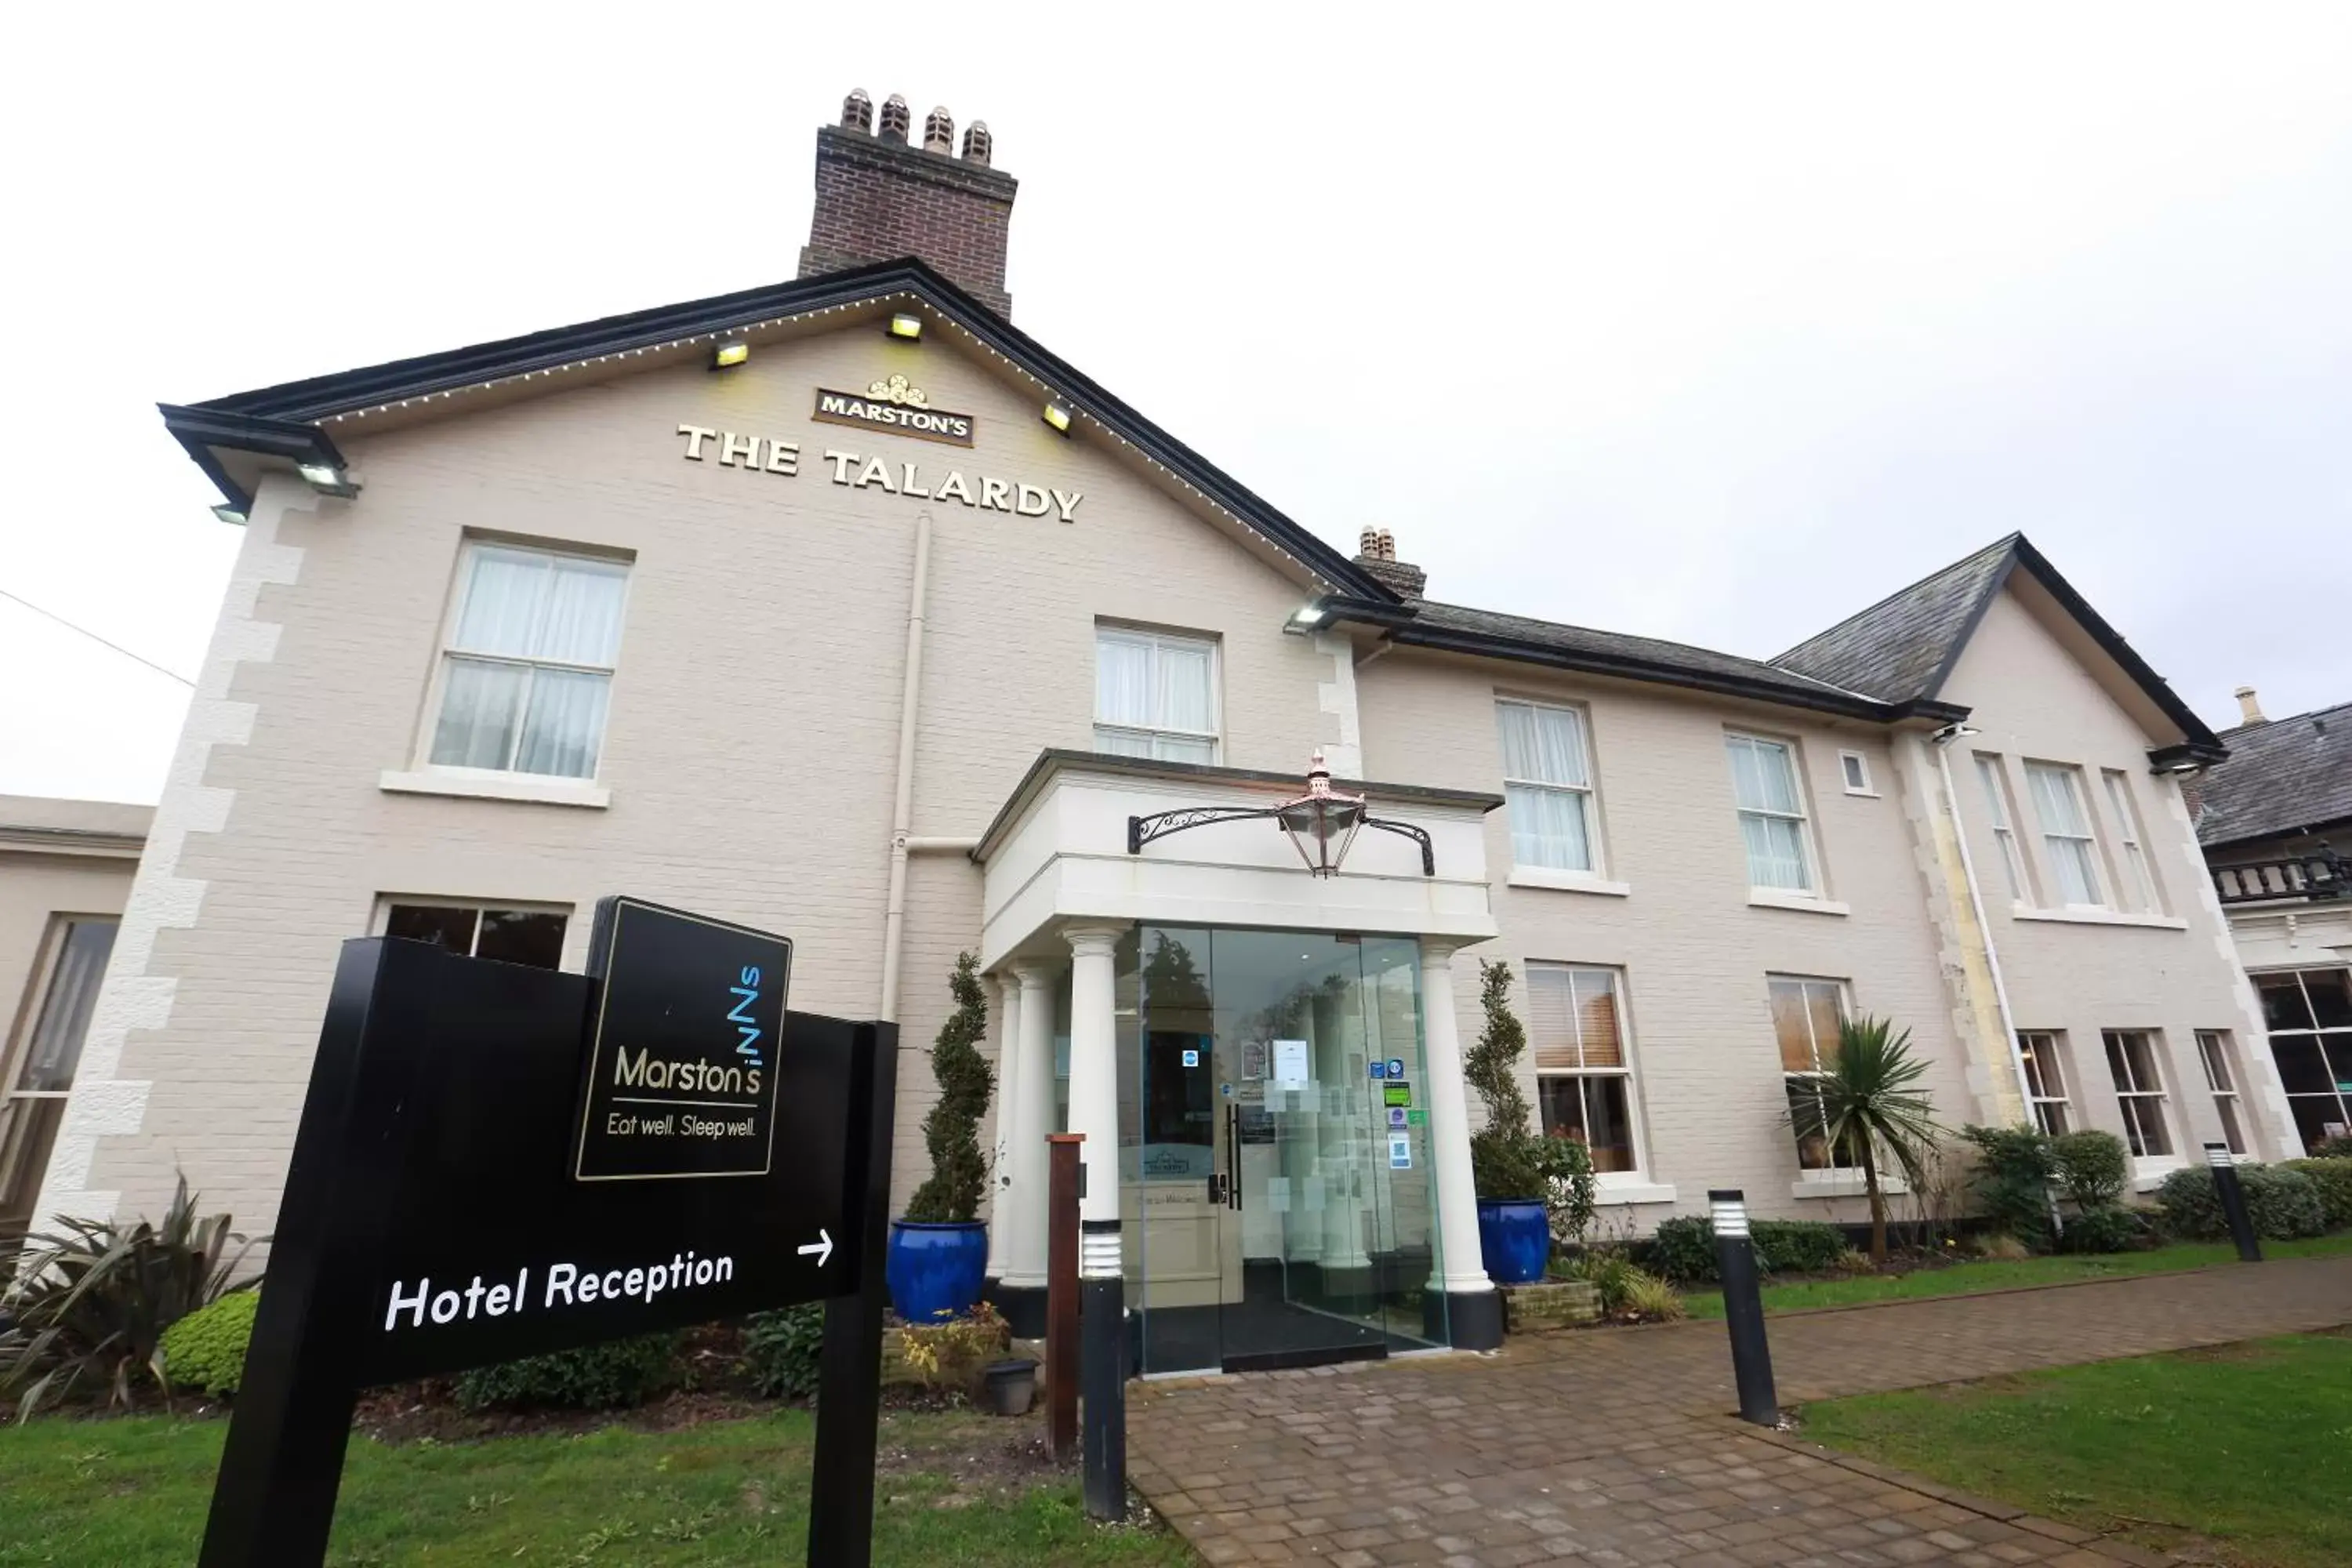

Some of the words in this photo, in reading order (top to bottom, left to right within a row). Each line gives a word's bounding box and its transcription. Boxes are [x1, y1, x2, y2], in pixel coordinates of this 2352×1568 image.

[821, 396, 967, 437] MARSTON'S
[677, 423, 800, 476] THE
[824, 448, 1083, 523] TALARDY
[607, 1112, 637, 1134] Eat
[641, 1113, 675, 1136] well.
[680, 1114, 724, 1140] Sleep
[727, 1116, 757, 1137] well.
[384, 1267, 528, 1331] Hotel
[545, 1250, 734, 1308] Reception
